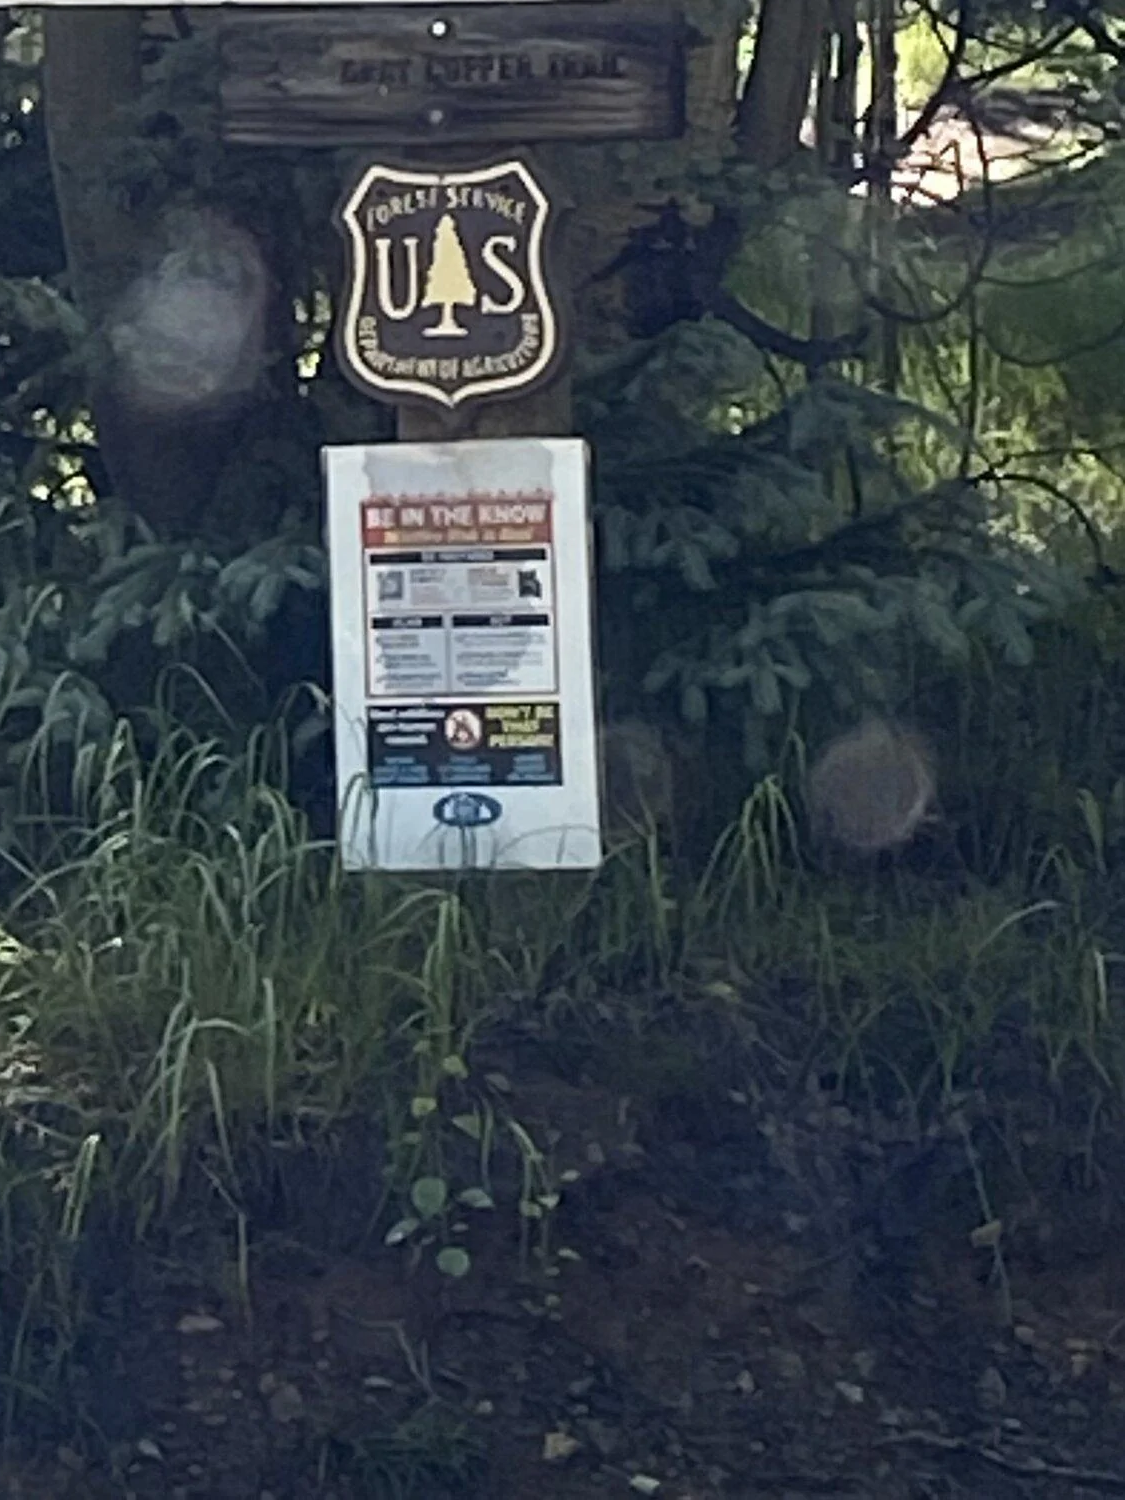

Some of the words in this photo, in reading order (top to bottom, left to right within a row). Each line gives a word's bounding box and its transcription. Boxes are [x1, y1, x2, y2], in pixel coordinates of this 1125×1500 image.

[366, 506, 396, 529] BE
[400, 506, 425, 527] IN
[430, 504, 473, 527] THE
[478, 503, 547, 526] KNOW
